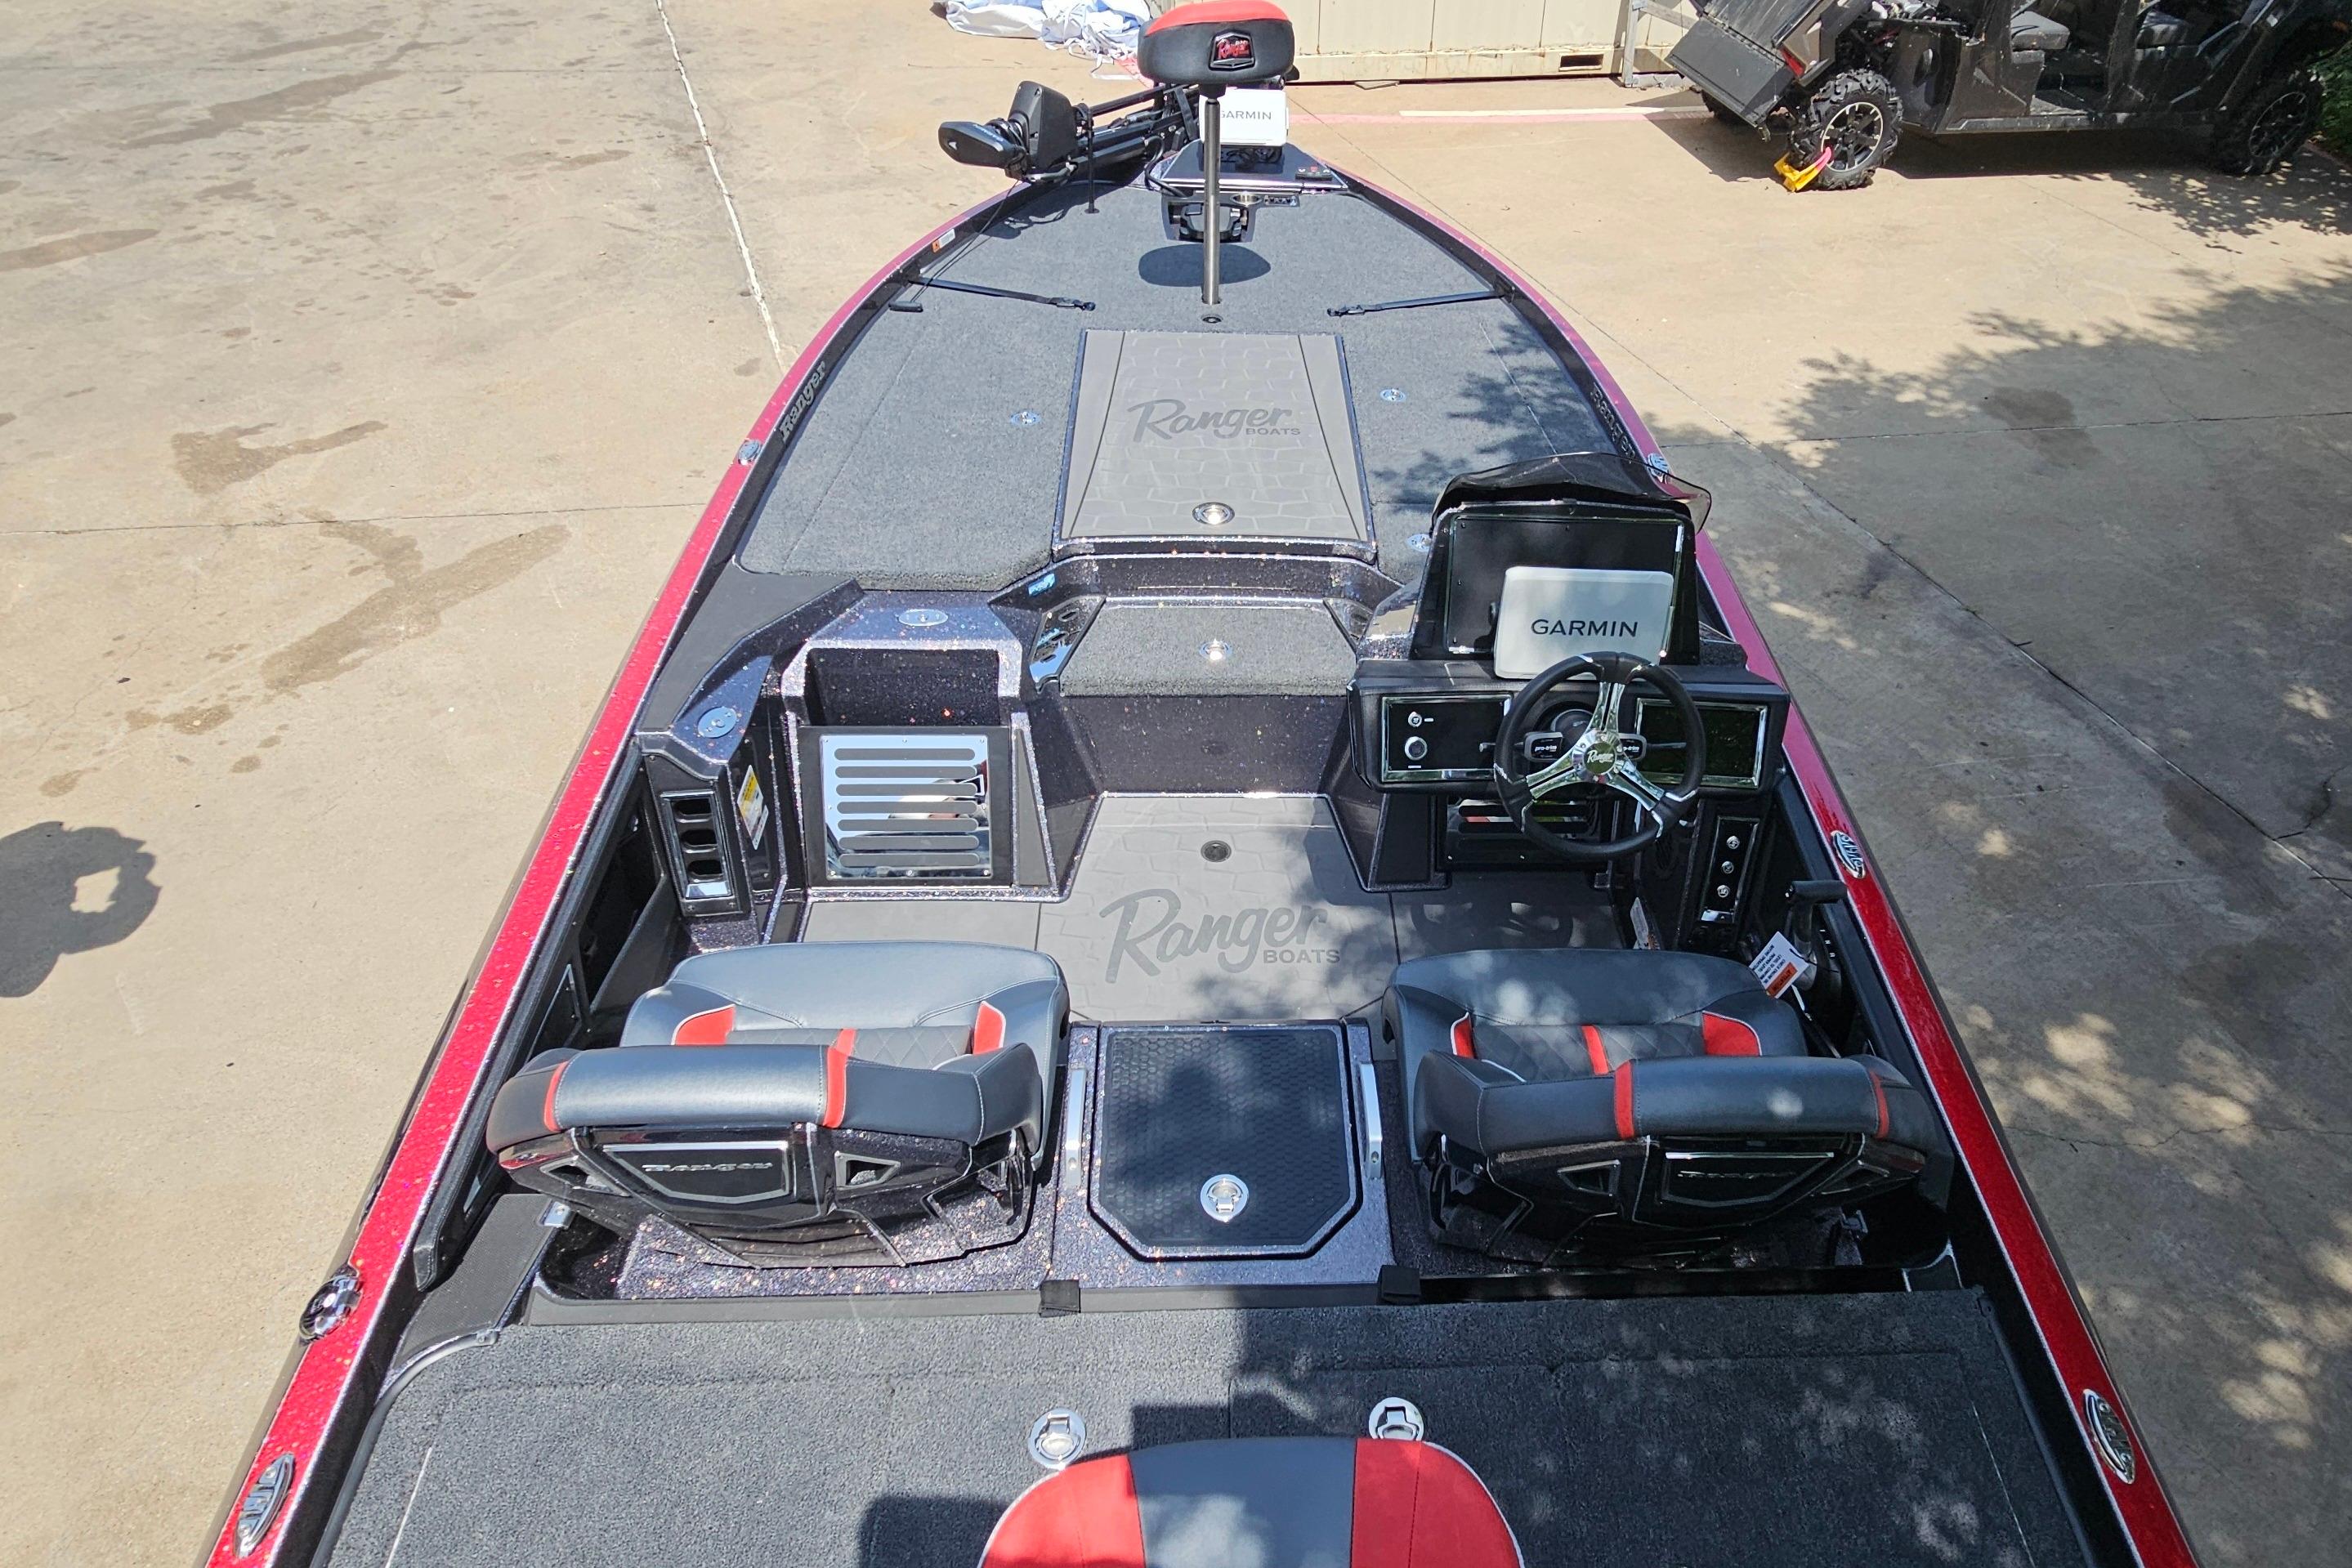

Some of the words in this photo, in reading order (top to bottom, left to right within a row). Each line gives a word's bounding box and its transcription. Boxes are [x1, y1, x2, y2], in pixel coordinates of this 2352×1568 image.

[779, 360, 826, 443] Ranger
[1127, 399, 1292, 443] Ranger
[1245, 427, 1301, 436] BOATS
[1531, 619, 1639, 637] GARMIN
[1099, 888, 1328, 984] Ranger
[1263, 949, 1340, 963] BOATS
